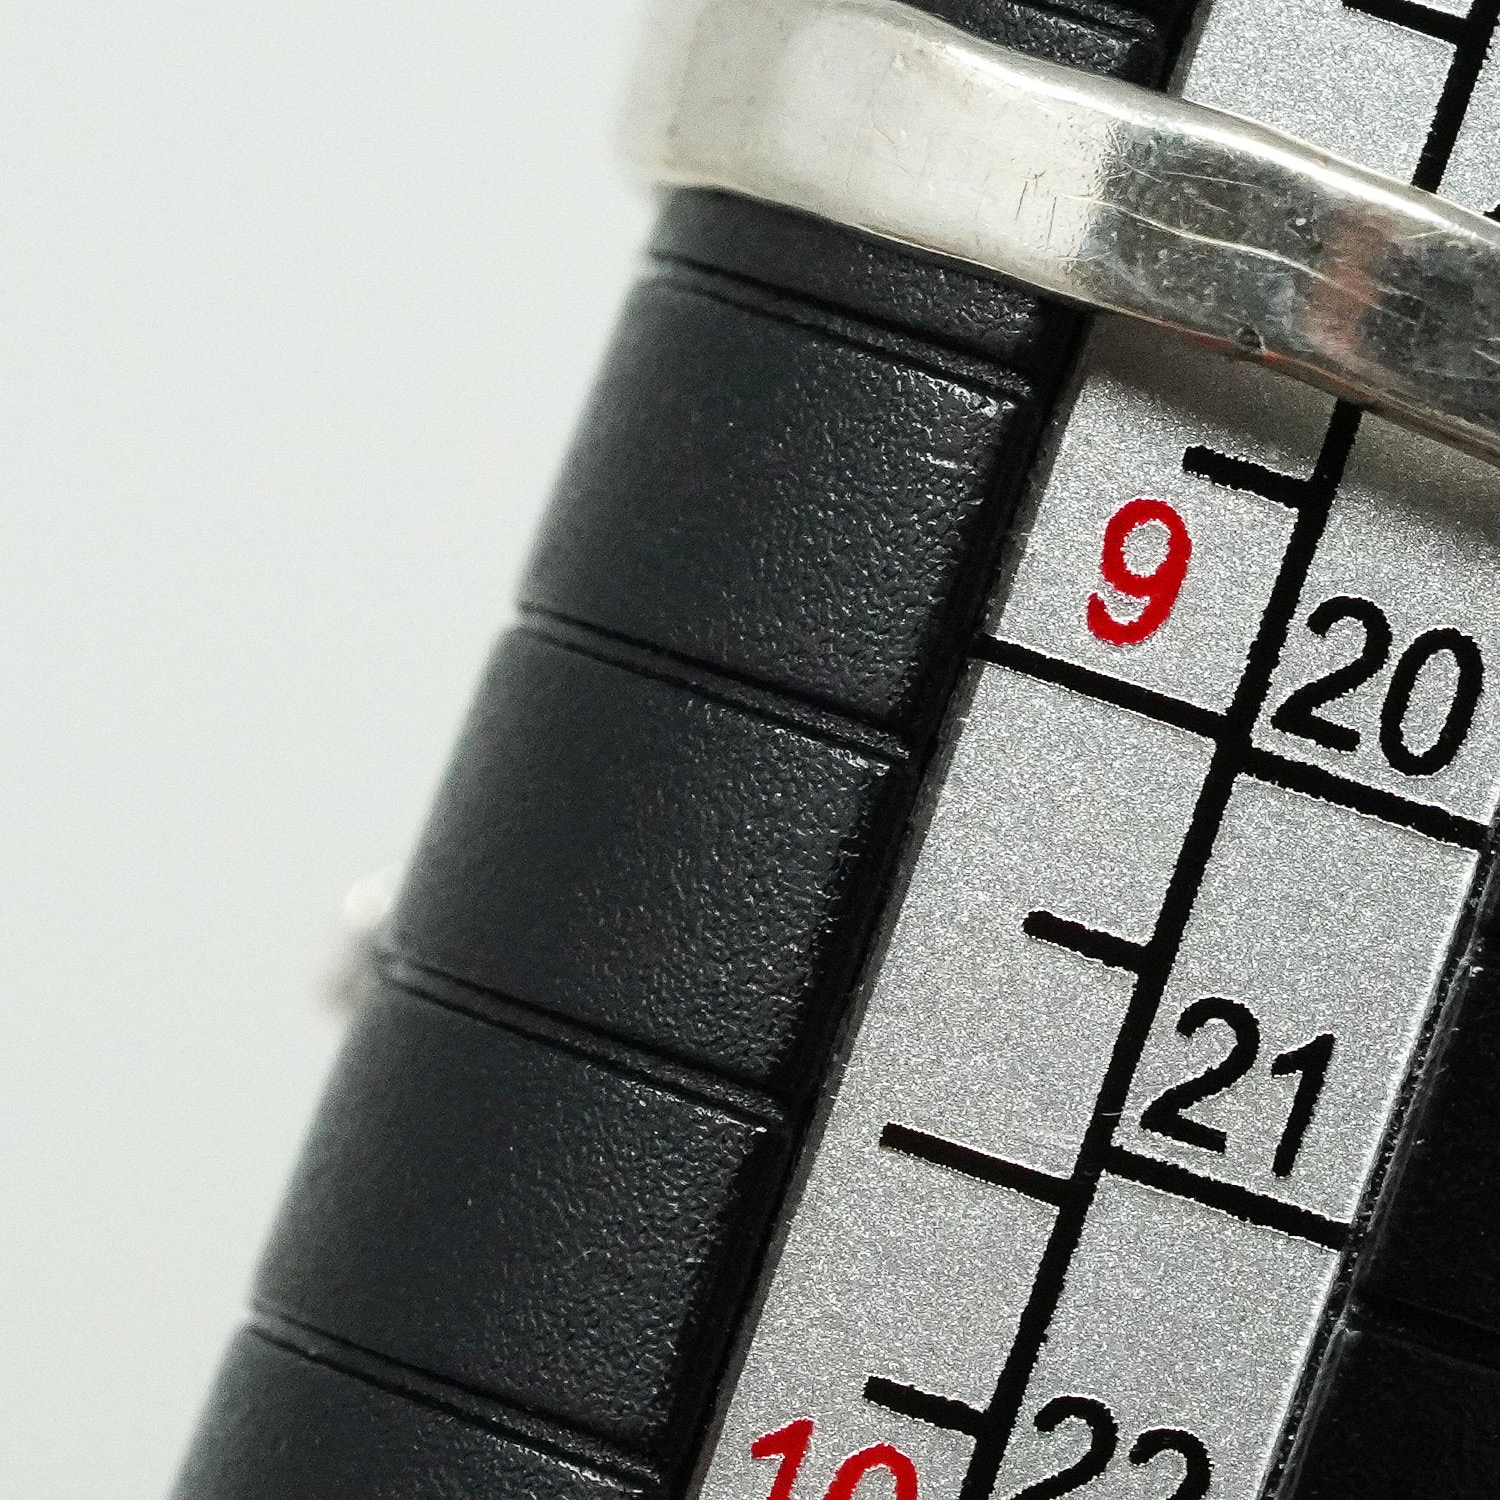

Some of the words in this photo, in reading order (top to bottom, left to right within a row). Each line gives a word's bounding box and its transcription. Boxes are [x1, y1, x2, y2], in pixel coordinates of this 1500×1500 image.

[1087, 499, 1193, 648] 9
[1270, 596, 1486, 778] 20
[1139, 997, 1338, 1181] 21
